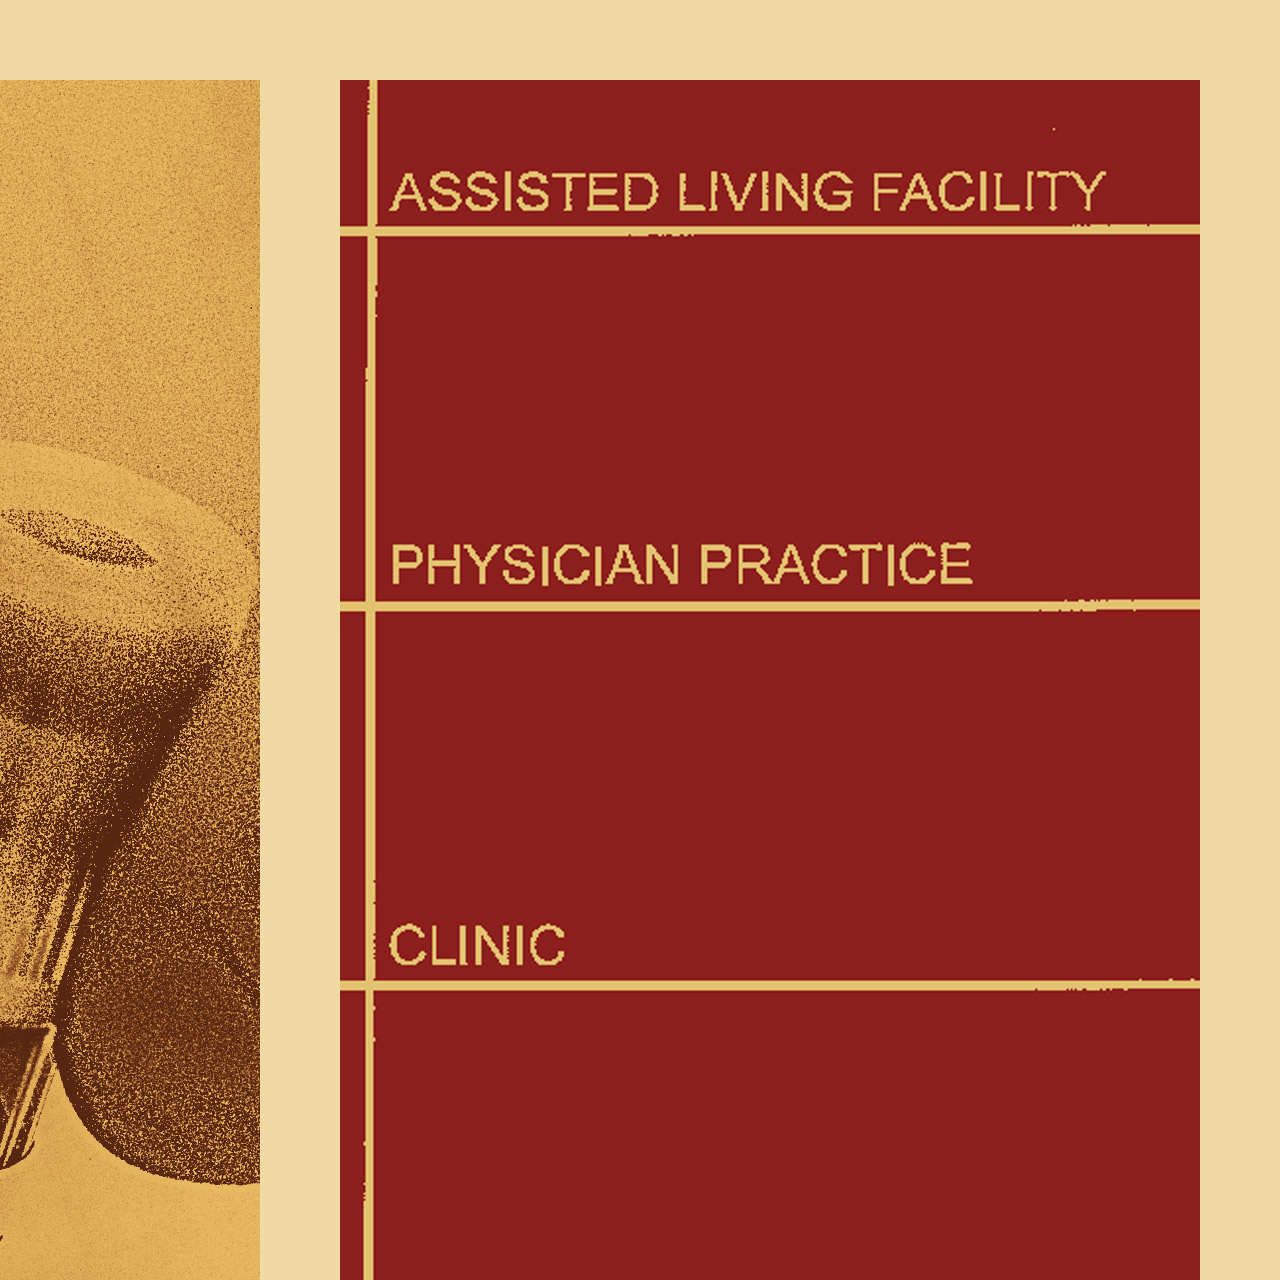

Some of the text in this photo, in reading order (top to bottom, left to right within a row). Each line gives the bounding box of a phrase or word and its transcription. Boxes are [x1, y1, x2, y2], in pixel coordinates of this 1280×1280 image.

[388, 170, 1107, 212] ASSISTED LIVING FACILITY
[392, 541, 974, 587] PHYSICIAN PRACTICE
[388, 923, 565, 966] CLINIC
